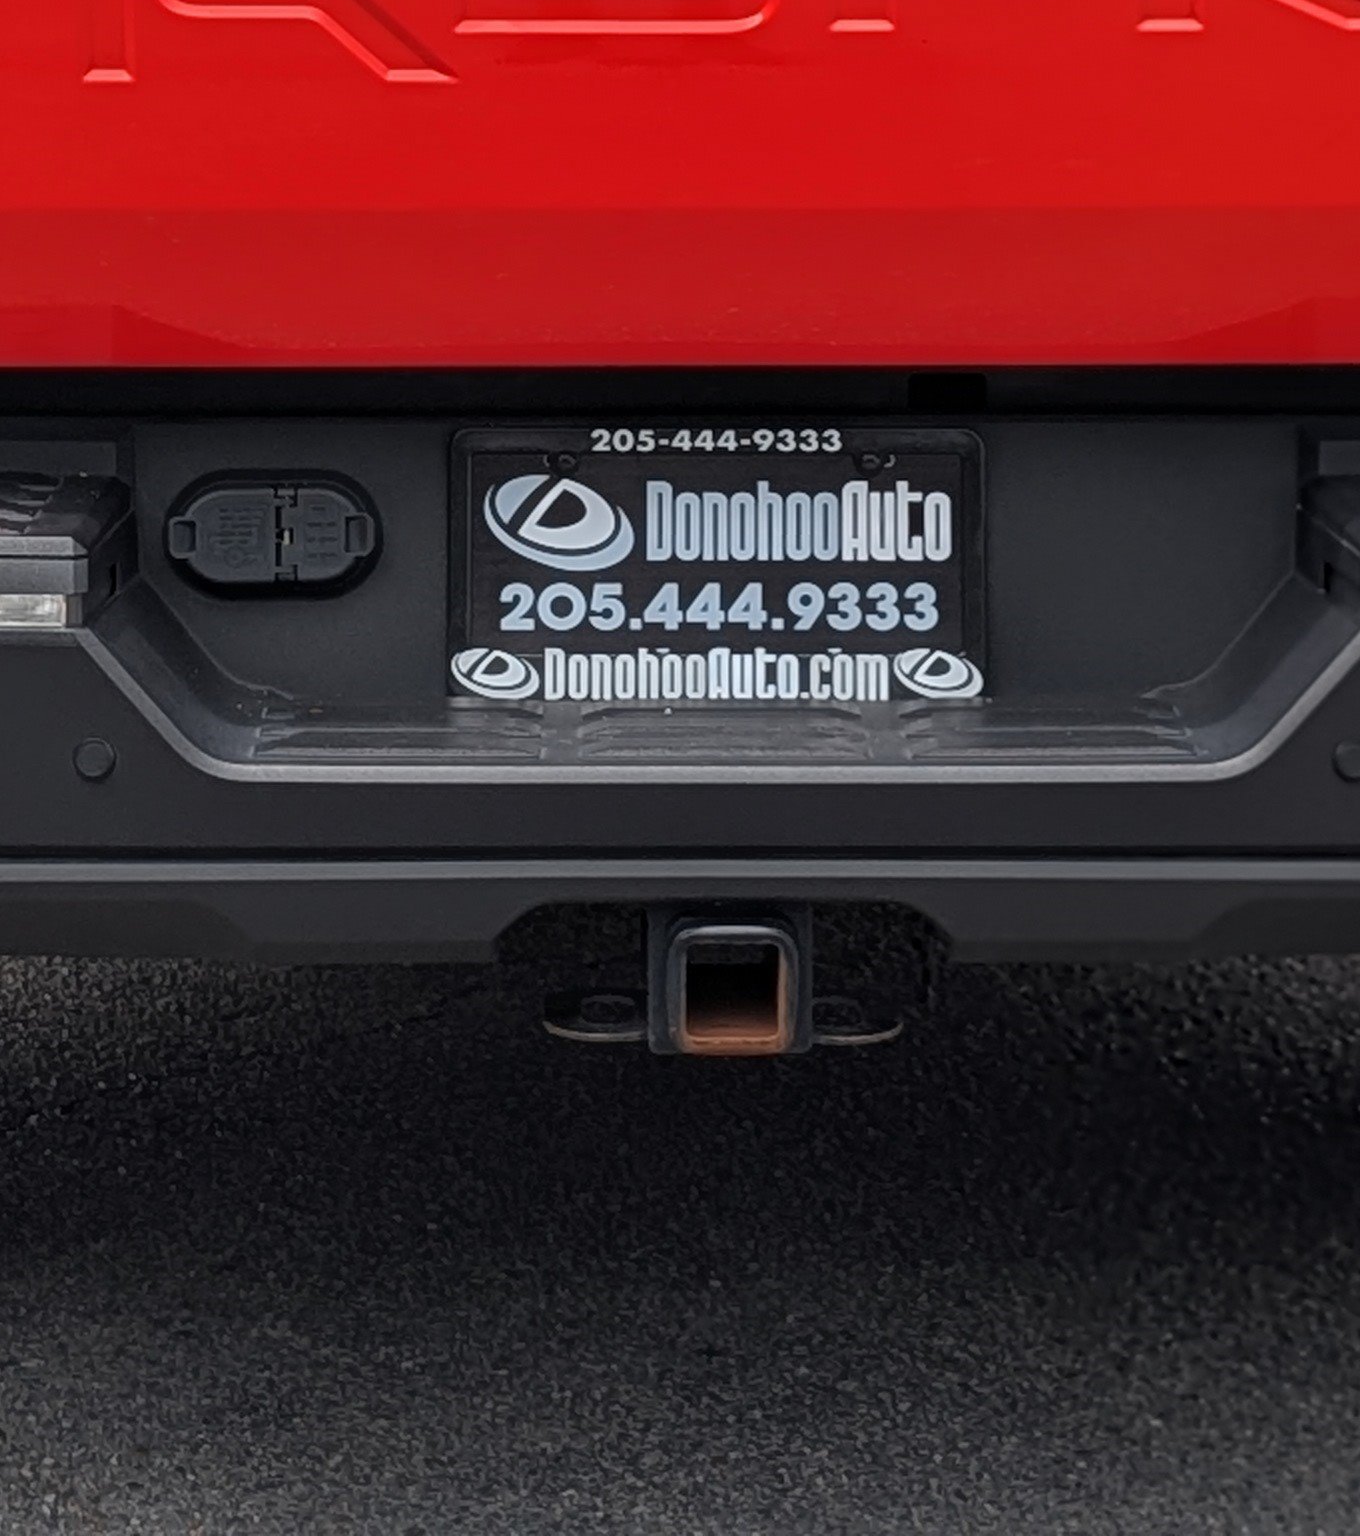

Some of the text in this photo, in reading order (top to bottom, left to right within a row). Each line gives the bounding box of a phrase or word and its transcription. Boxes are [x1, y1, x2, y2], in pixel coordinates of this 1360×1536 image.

[590, 428, 842, 453] 205-444-9333
[646, 480, 952, 562] DonohooAuto
[498, 582, 939, 632] 205.444.9333
[543, 648, 890, 701] DonohooAuto.com
